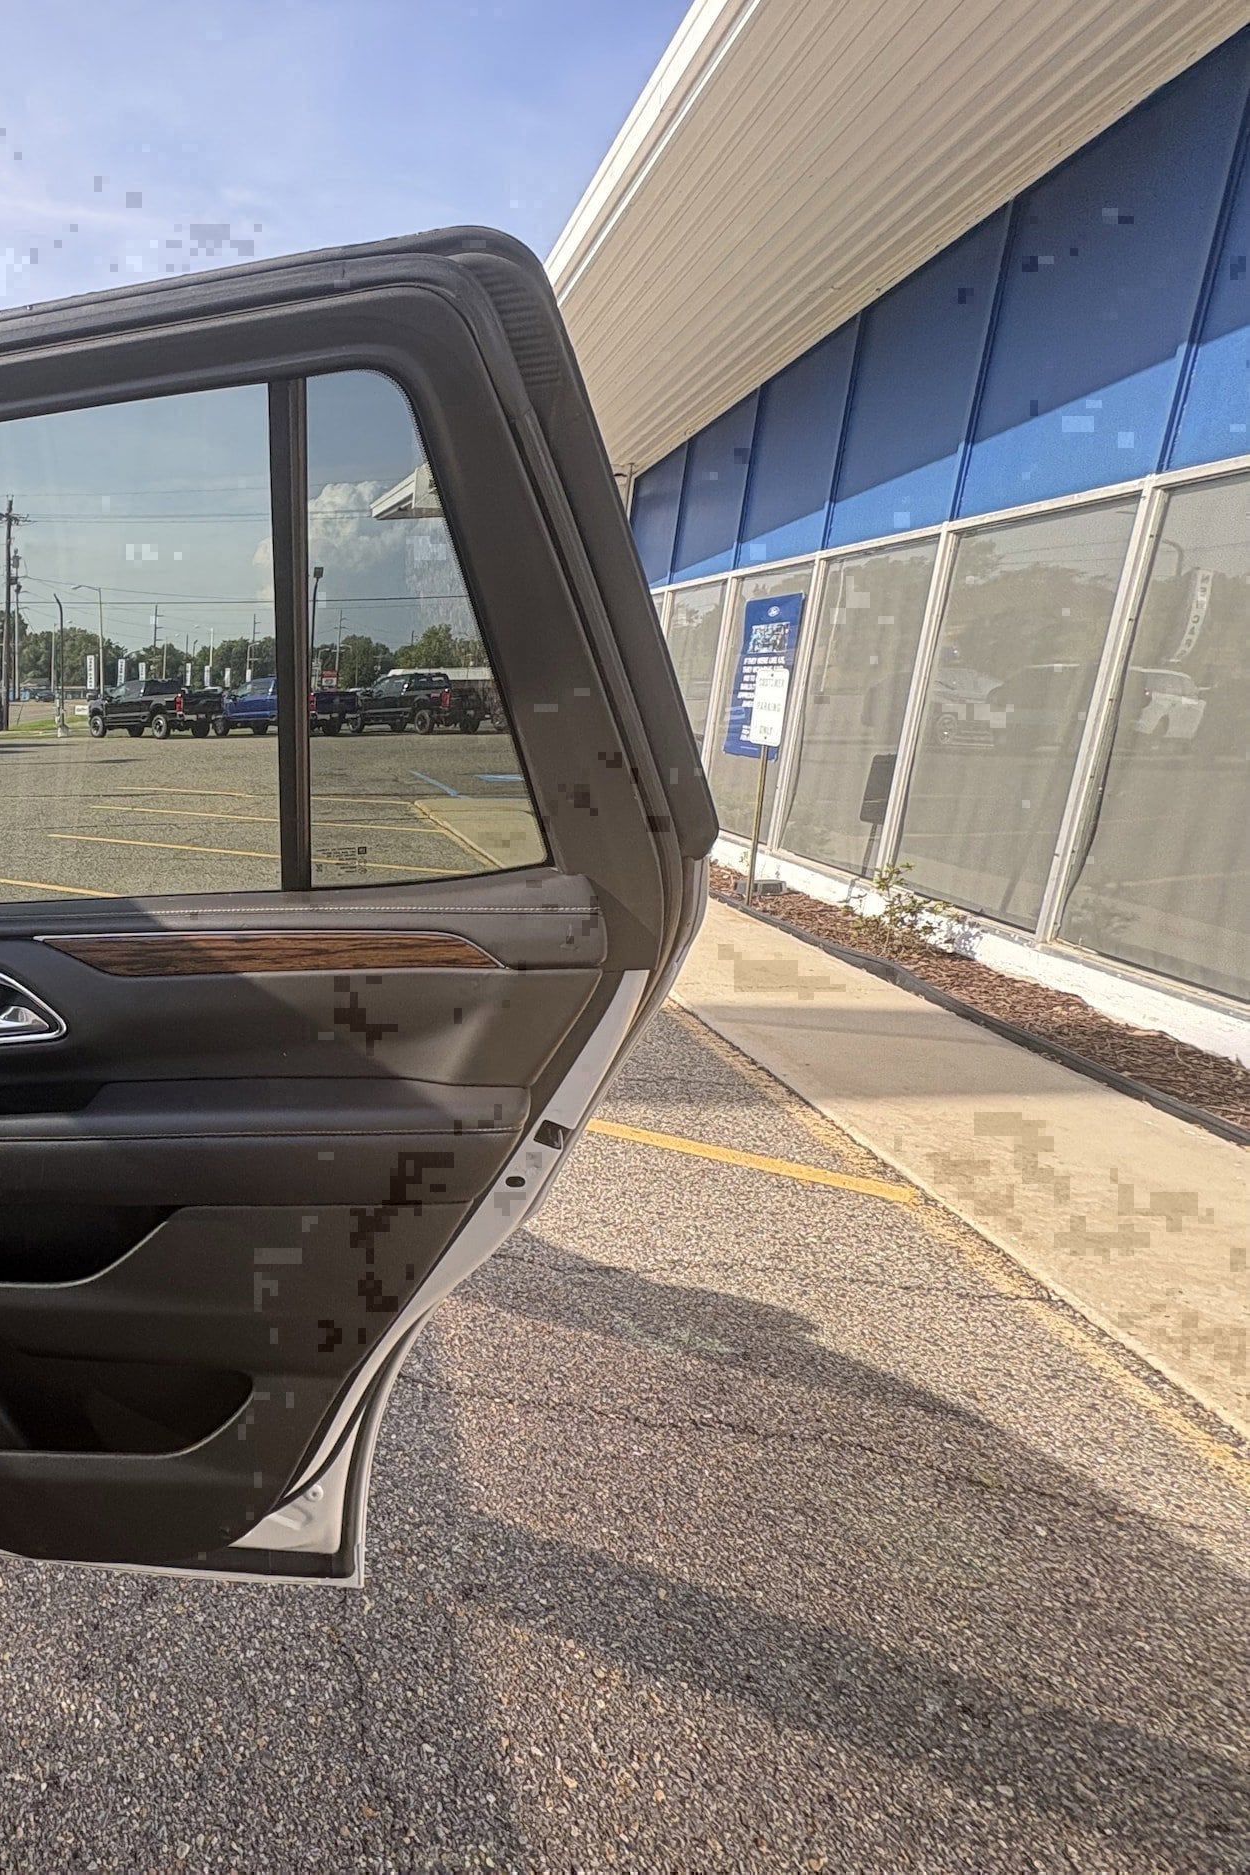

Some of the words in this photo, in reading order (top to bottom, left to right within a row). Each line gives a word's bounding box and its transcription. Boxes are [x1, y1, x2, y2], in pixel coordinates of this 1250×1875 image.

[758, 678, 785, 688] CUSTOMER
[756, 701, 781, 712] PARKING
[759, 725, 773, 736] ONLY
